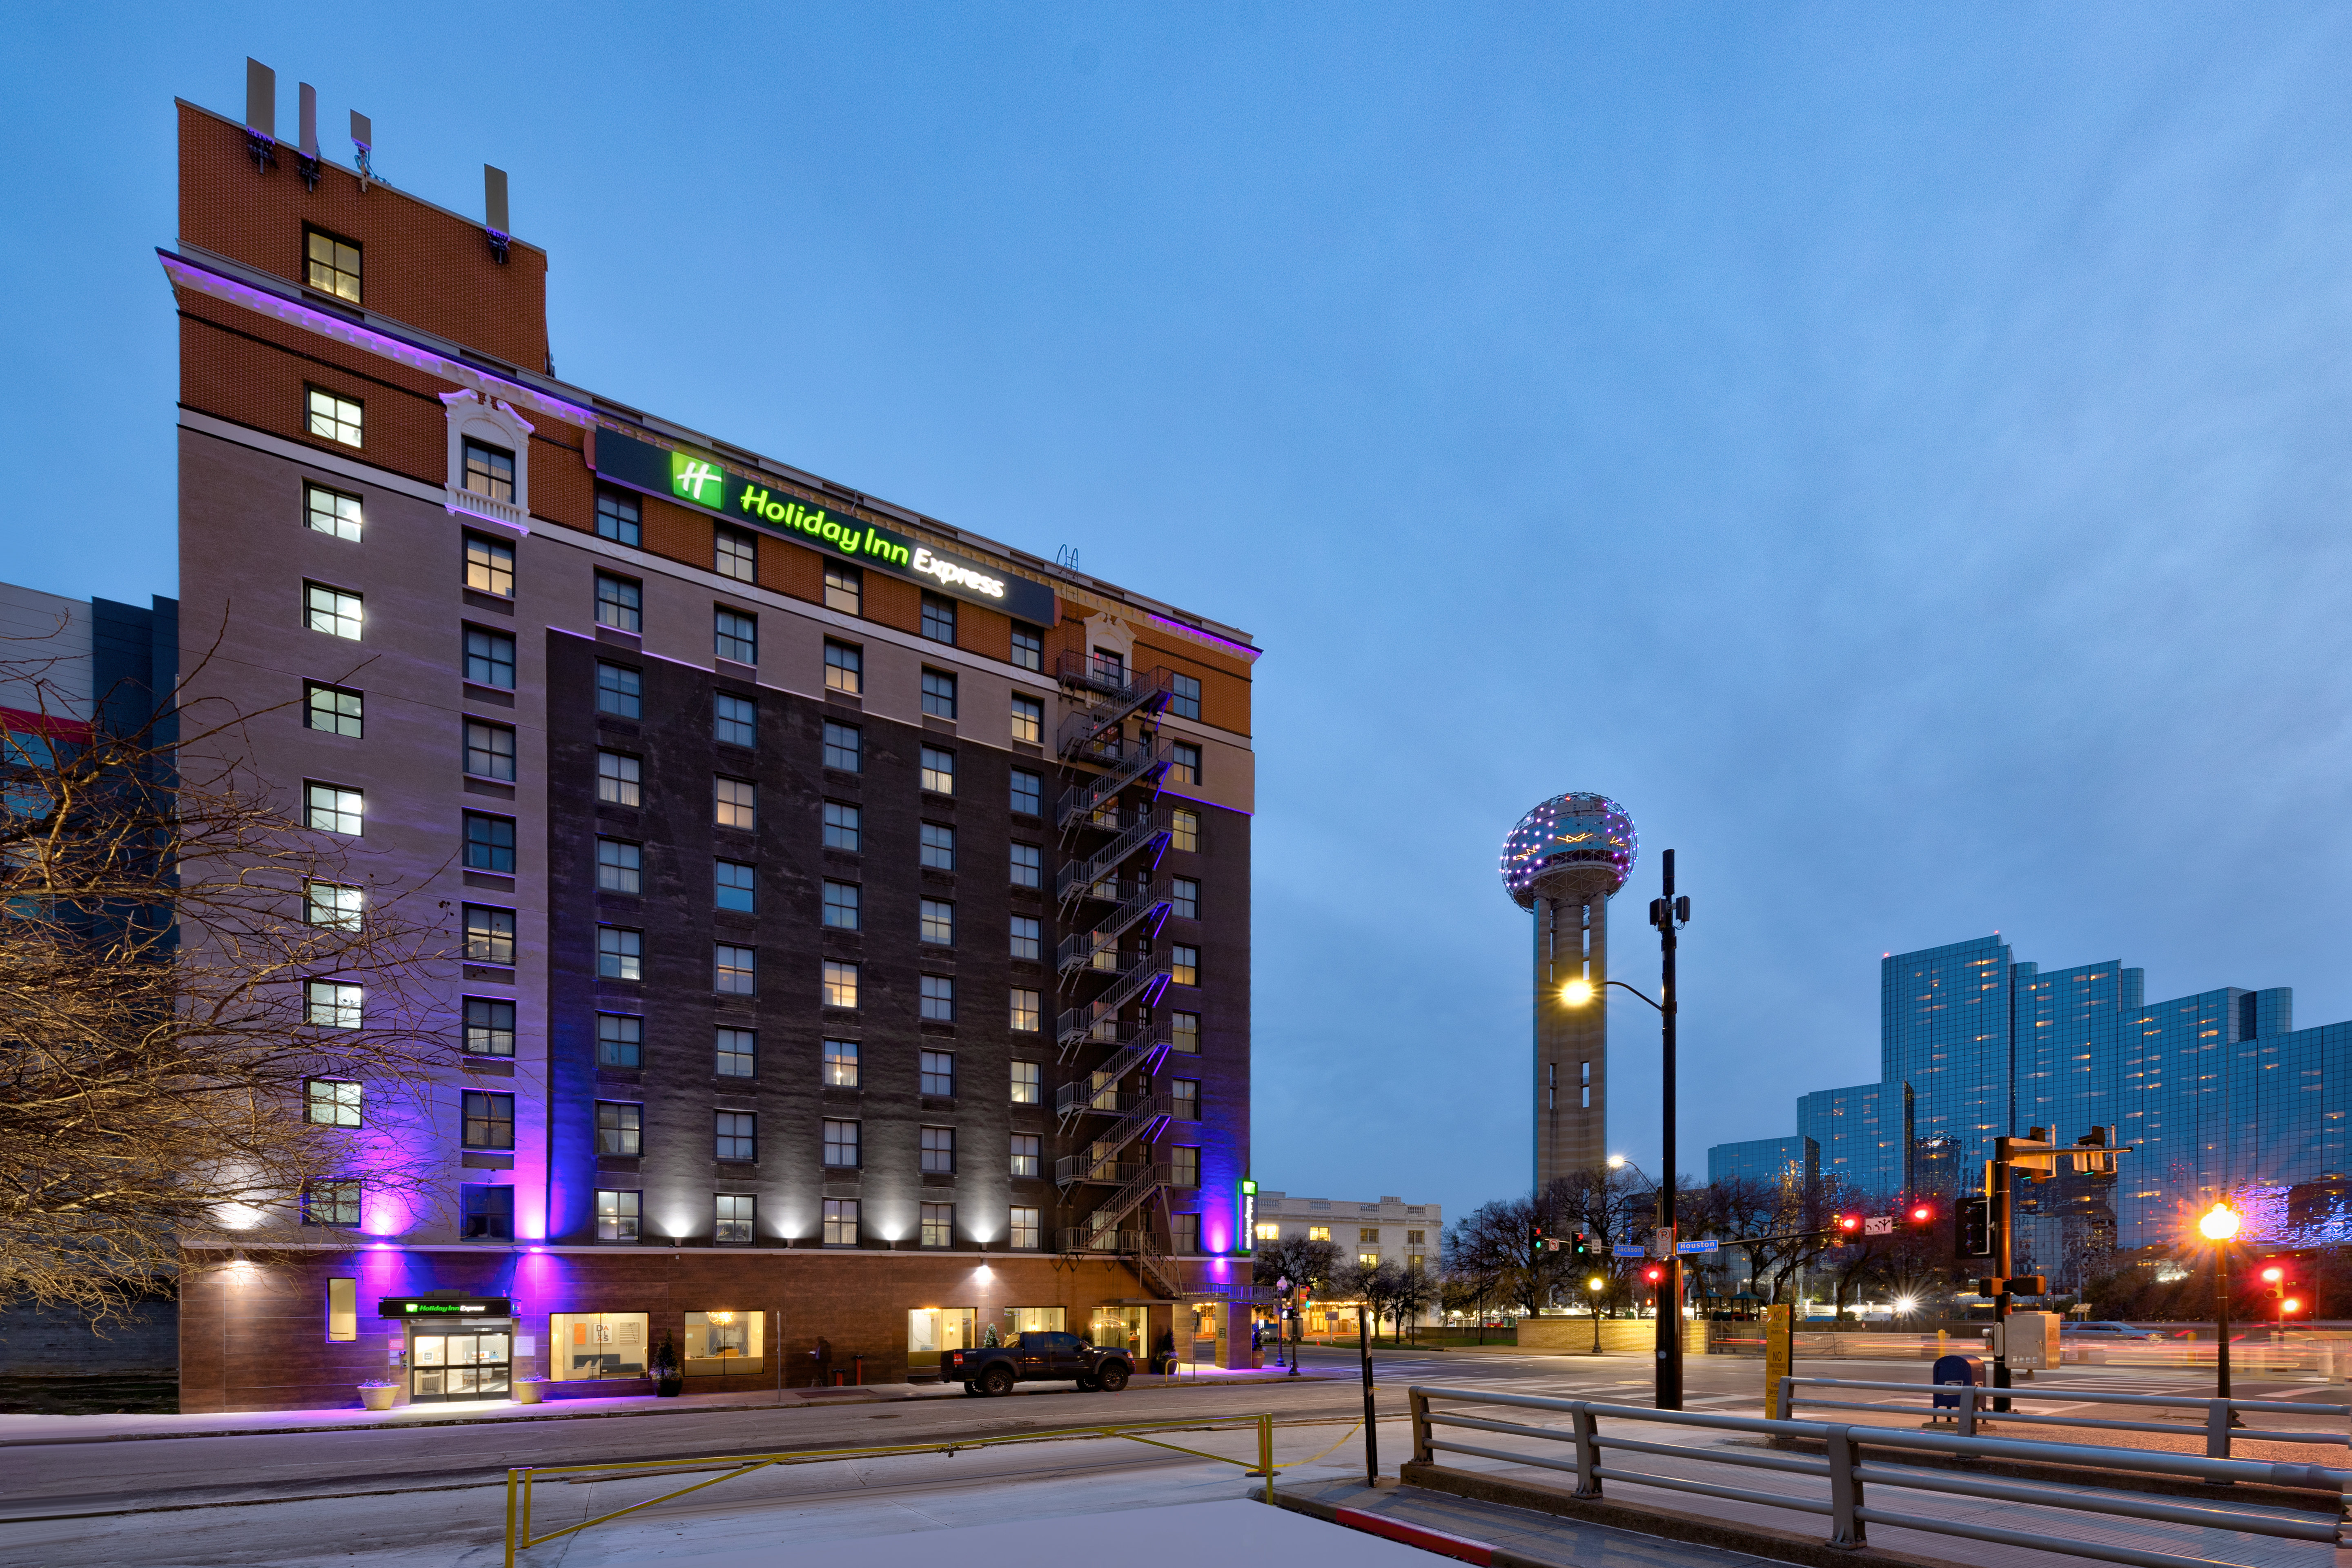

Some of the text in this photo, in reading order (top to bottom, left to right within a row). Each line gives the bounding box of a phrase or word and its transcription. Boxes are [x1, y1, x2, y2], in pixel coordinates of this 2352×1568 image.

[740, 484, 1004, 598] Holiday Inn Express
[1774, 1311, 1782, 1321] NO
[1773, 1351, 1782, 1361] NO
